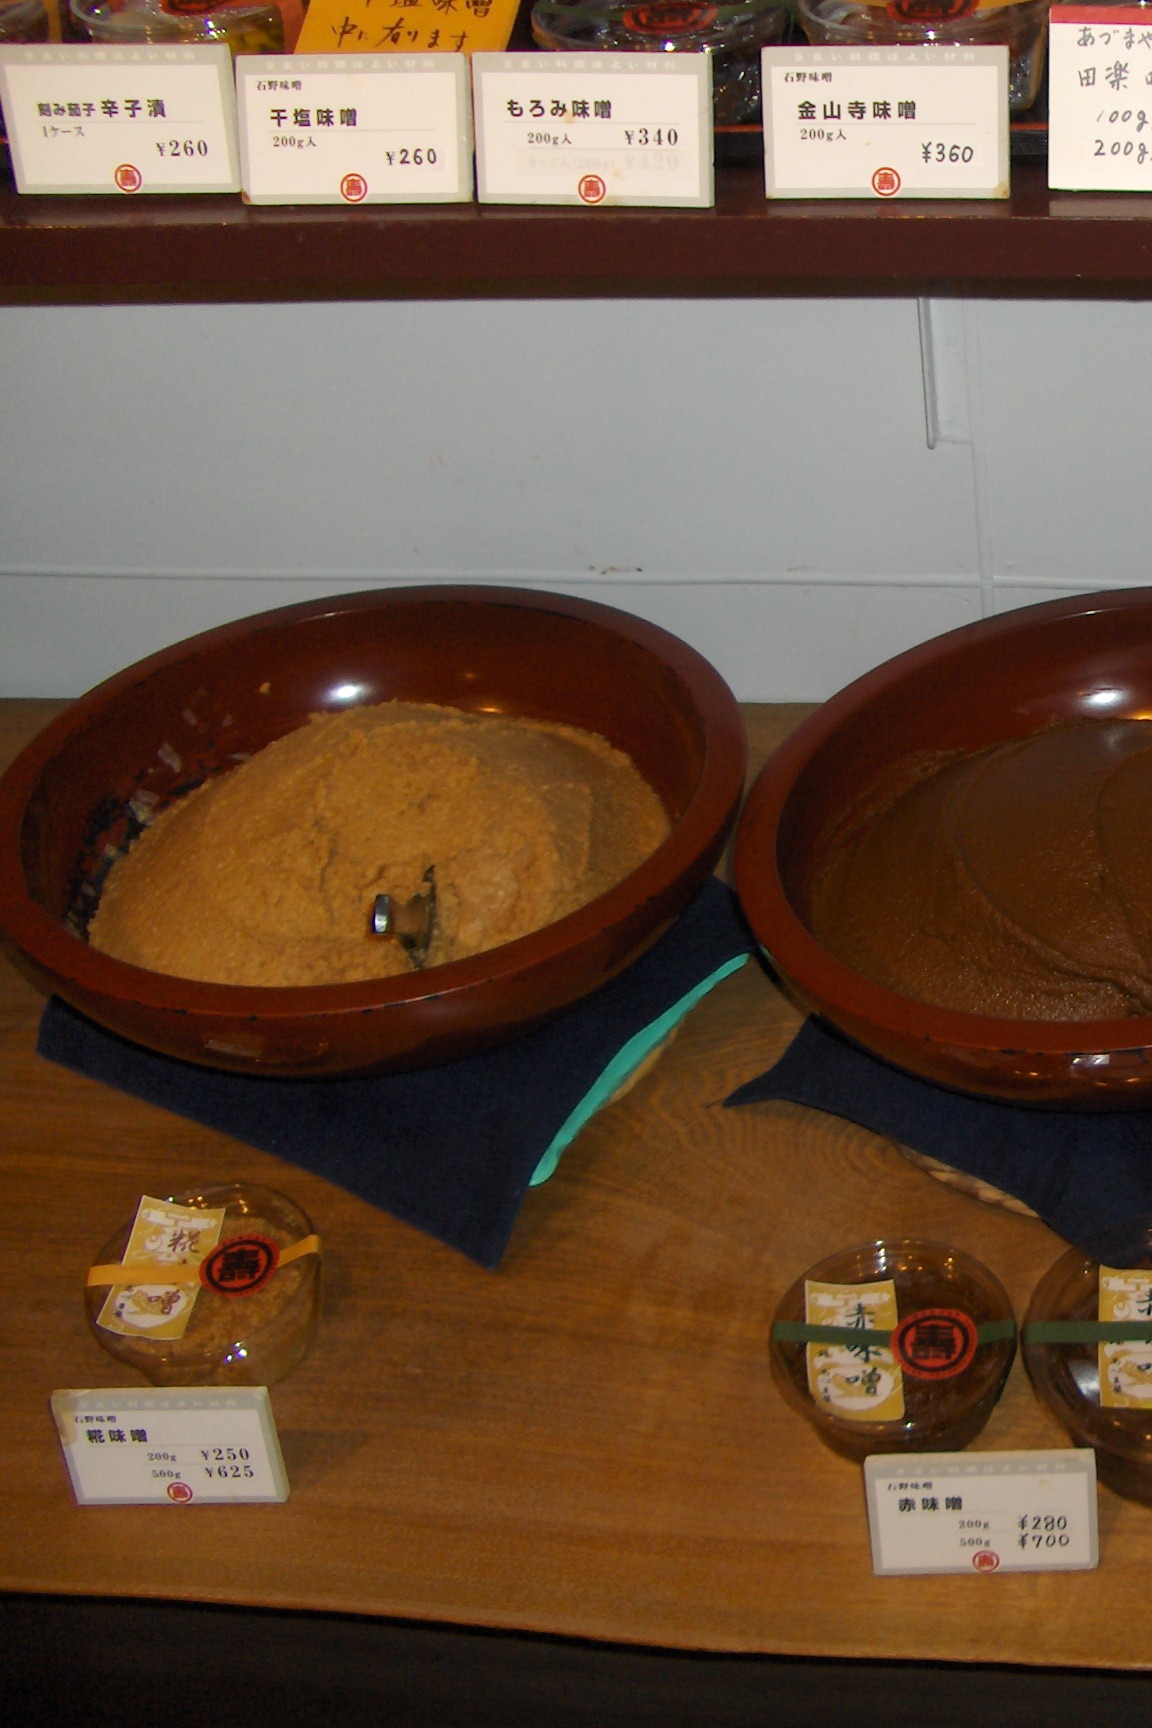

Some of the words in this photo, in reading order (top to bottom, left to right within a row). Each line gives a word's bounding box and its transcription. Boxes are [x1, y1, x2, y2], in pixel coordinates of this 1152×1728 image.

[784, 72, 833, 83] 石野味噌
[507, 99, 612, 119] もろみ味噌
[798, 100, 917, 120] 金山寺味噌
[624, 128, 678, 146] ¥340
[155, 140, 208, 157] ¥260
[385, 148, 437, 166] ¥260
[921, 142, 974, 164] ¥360
[201, 1447, 250, 1461] ¥250
[205, 1465, 255, 1479] ¥625
[898, 1496, 963, 1512] 赤味噌
[1017, 1514, 1068, 1531] ¥280
[1017, 1533, 1070, 1549] ¥700
